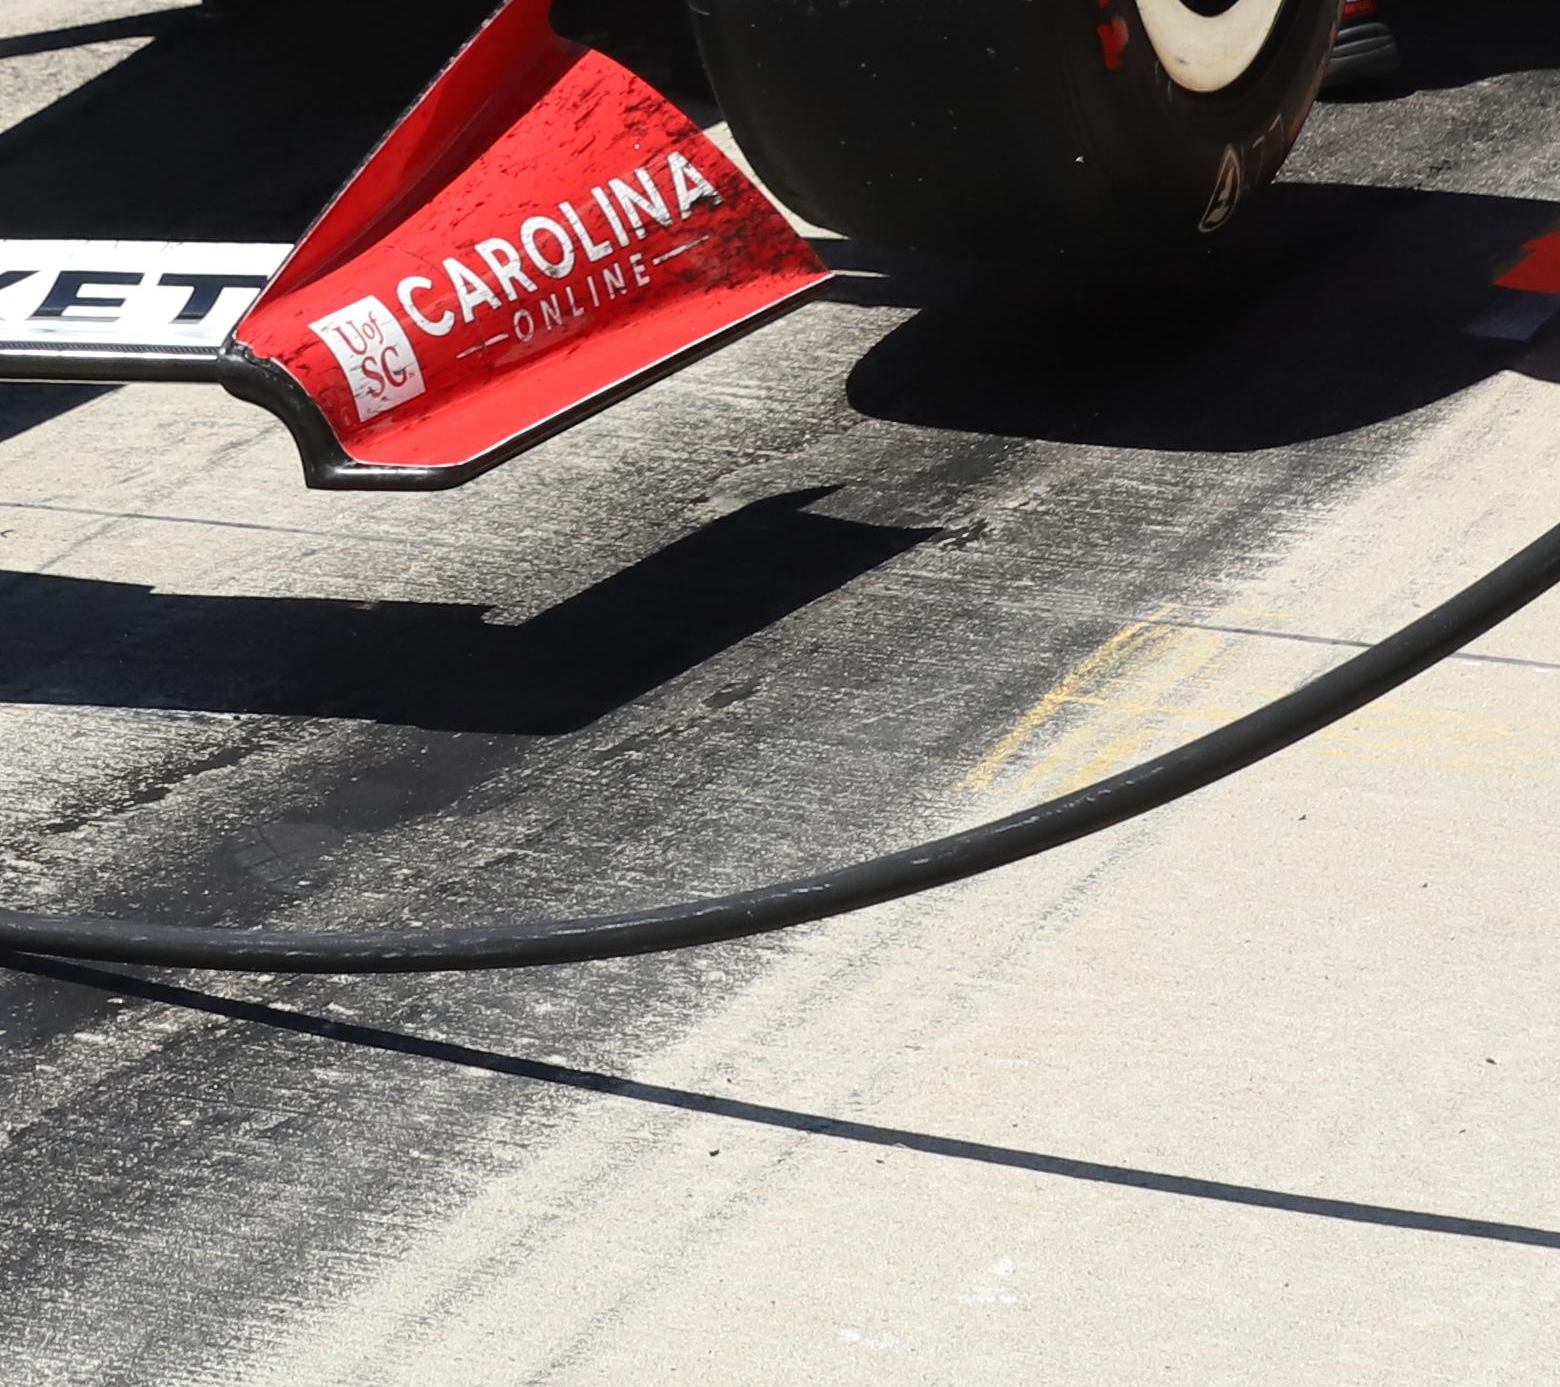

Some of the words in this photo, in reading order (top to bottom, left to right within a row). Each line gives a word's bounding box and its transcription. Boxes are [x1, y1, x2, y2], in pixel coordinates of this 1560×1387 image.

[396, 150, 723, 336] CAROLINA
[334, 309, 383, 355] Uof
[511, 252, 651, 344] ONLINE
[360, 344, 412, 399] SG
